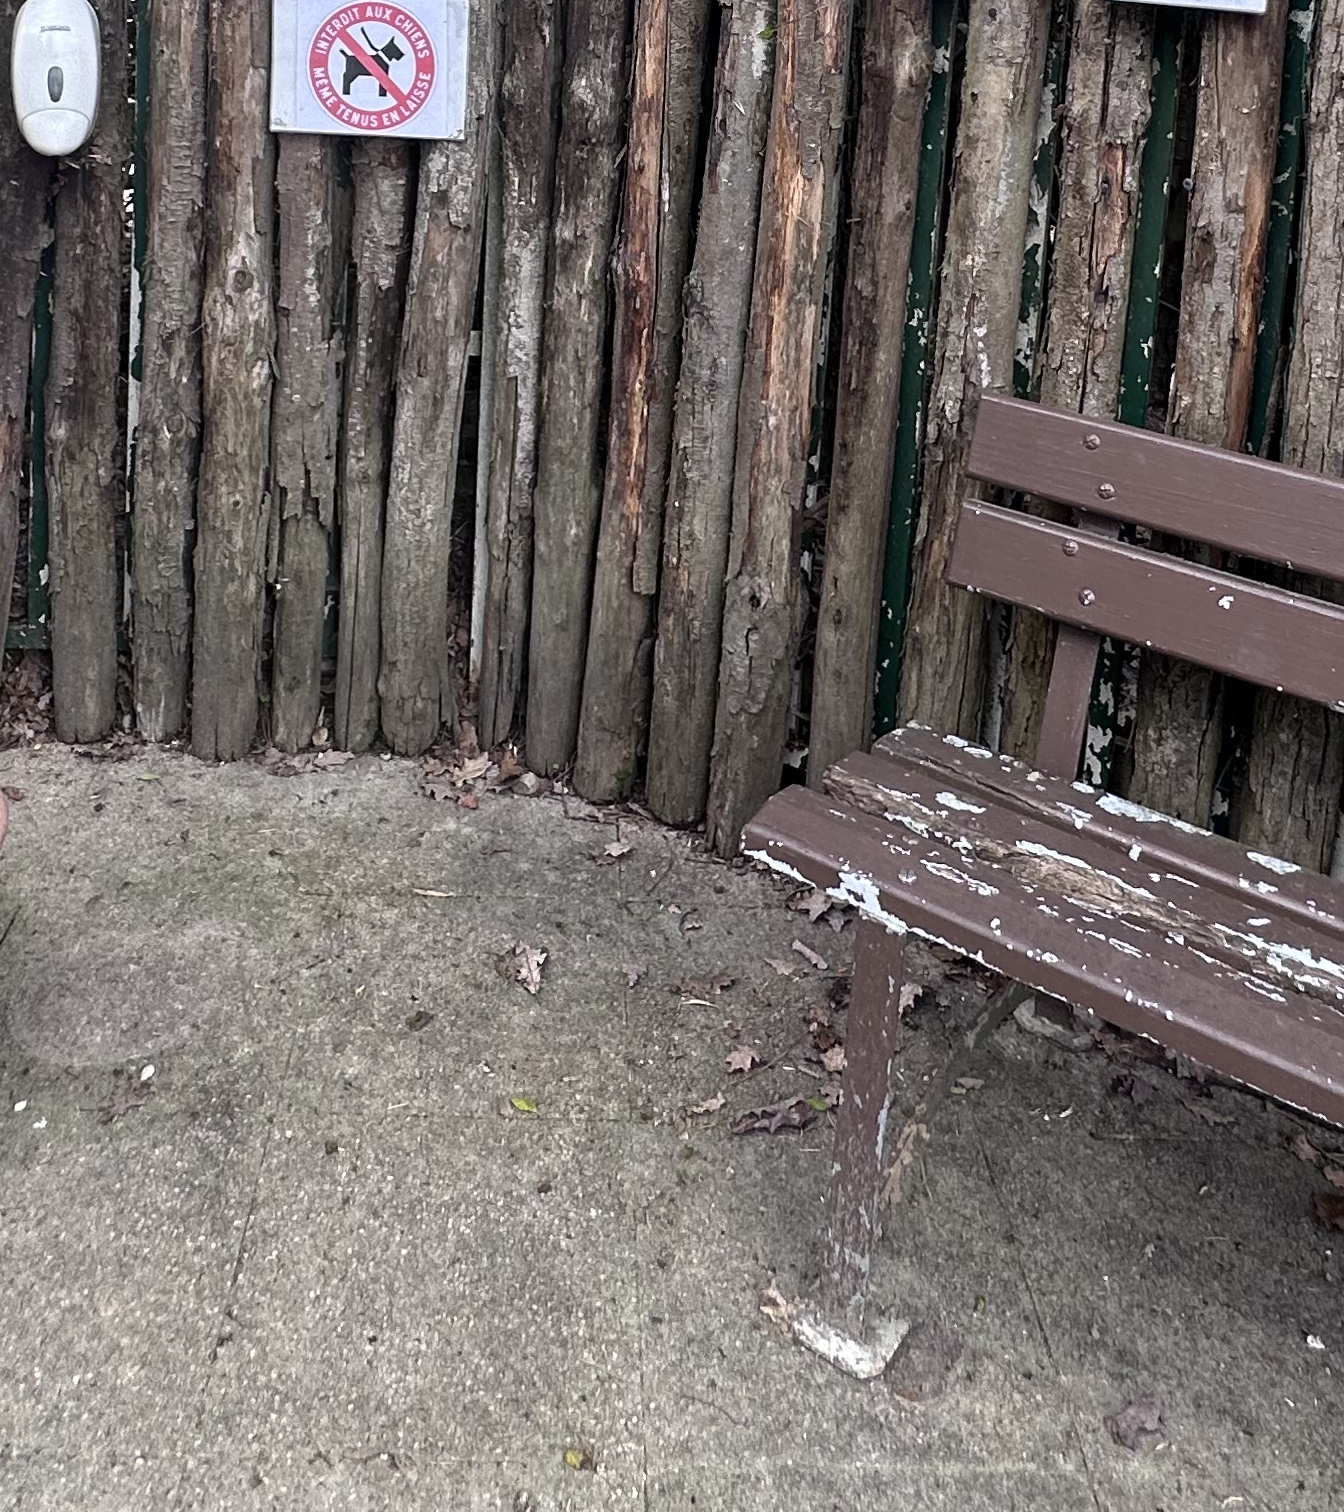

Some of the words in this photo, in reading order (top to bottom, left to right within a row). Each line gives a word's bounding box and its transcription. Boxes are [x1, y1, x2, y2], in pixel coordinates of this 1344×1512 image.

[315, 7, 360, 55] INTERDIT
[365, 5, 393, 21] AUX
[394, 14, 431, 59] CHIENS
[336, 103, 378, 128] TENUS
[381, 109, 400, 126] EN
[399, 71, 432, 116] LAISSE
